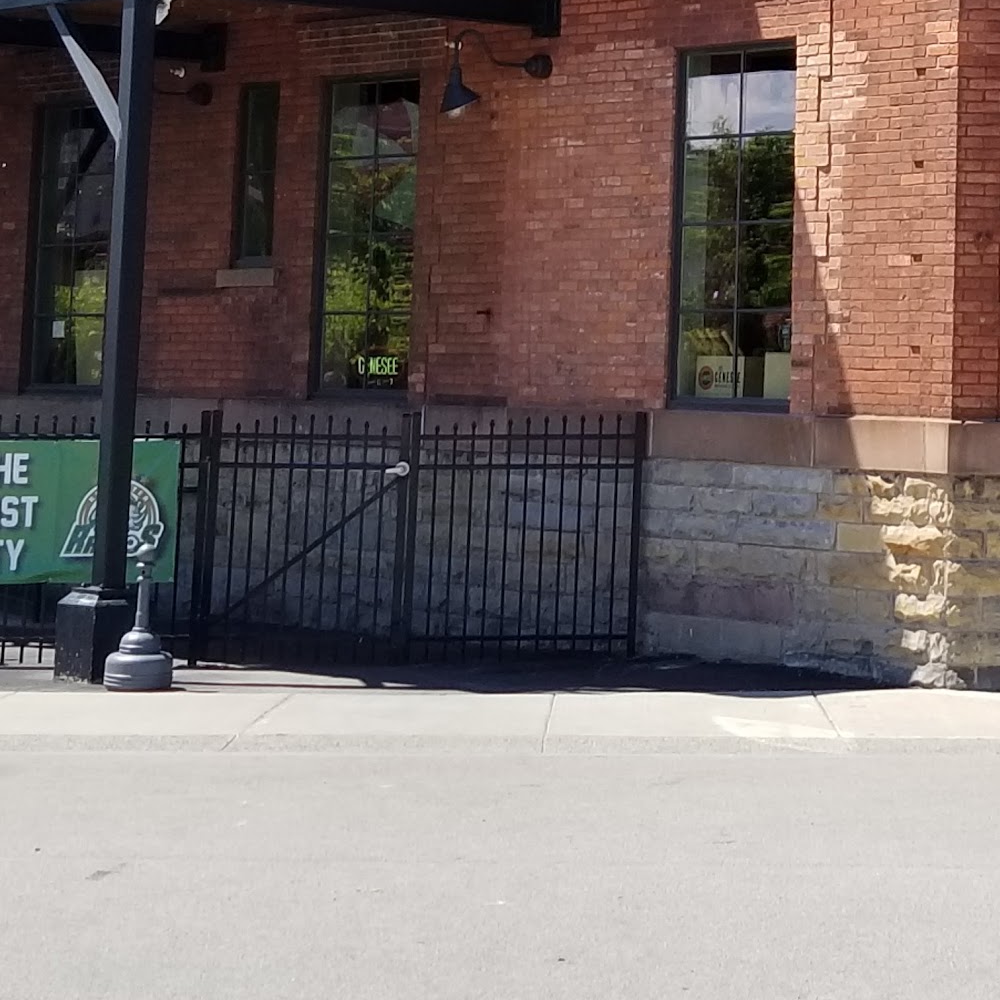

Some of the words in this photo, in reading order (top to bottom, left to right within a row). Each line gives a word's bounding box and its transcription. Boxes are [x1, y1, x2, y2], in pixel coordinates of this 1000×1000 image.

[358, 356, 399, 375] GNESEE
[714, 371, 741, 384] GENESE
[1, 496, 39, 528] ST
[0, 539, 25, 571] Y
